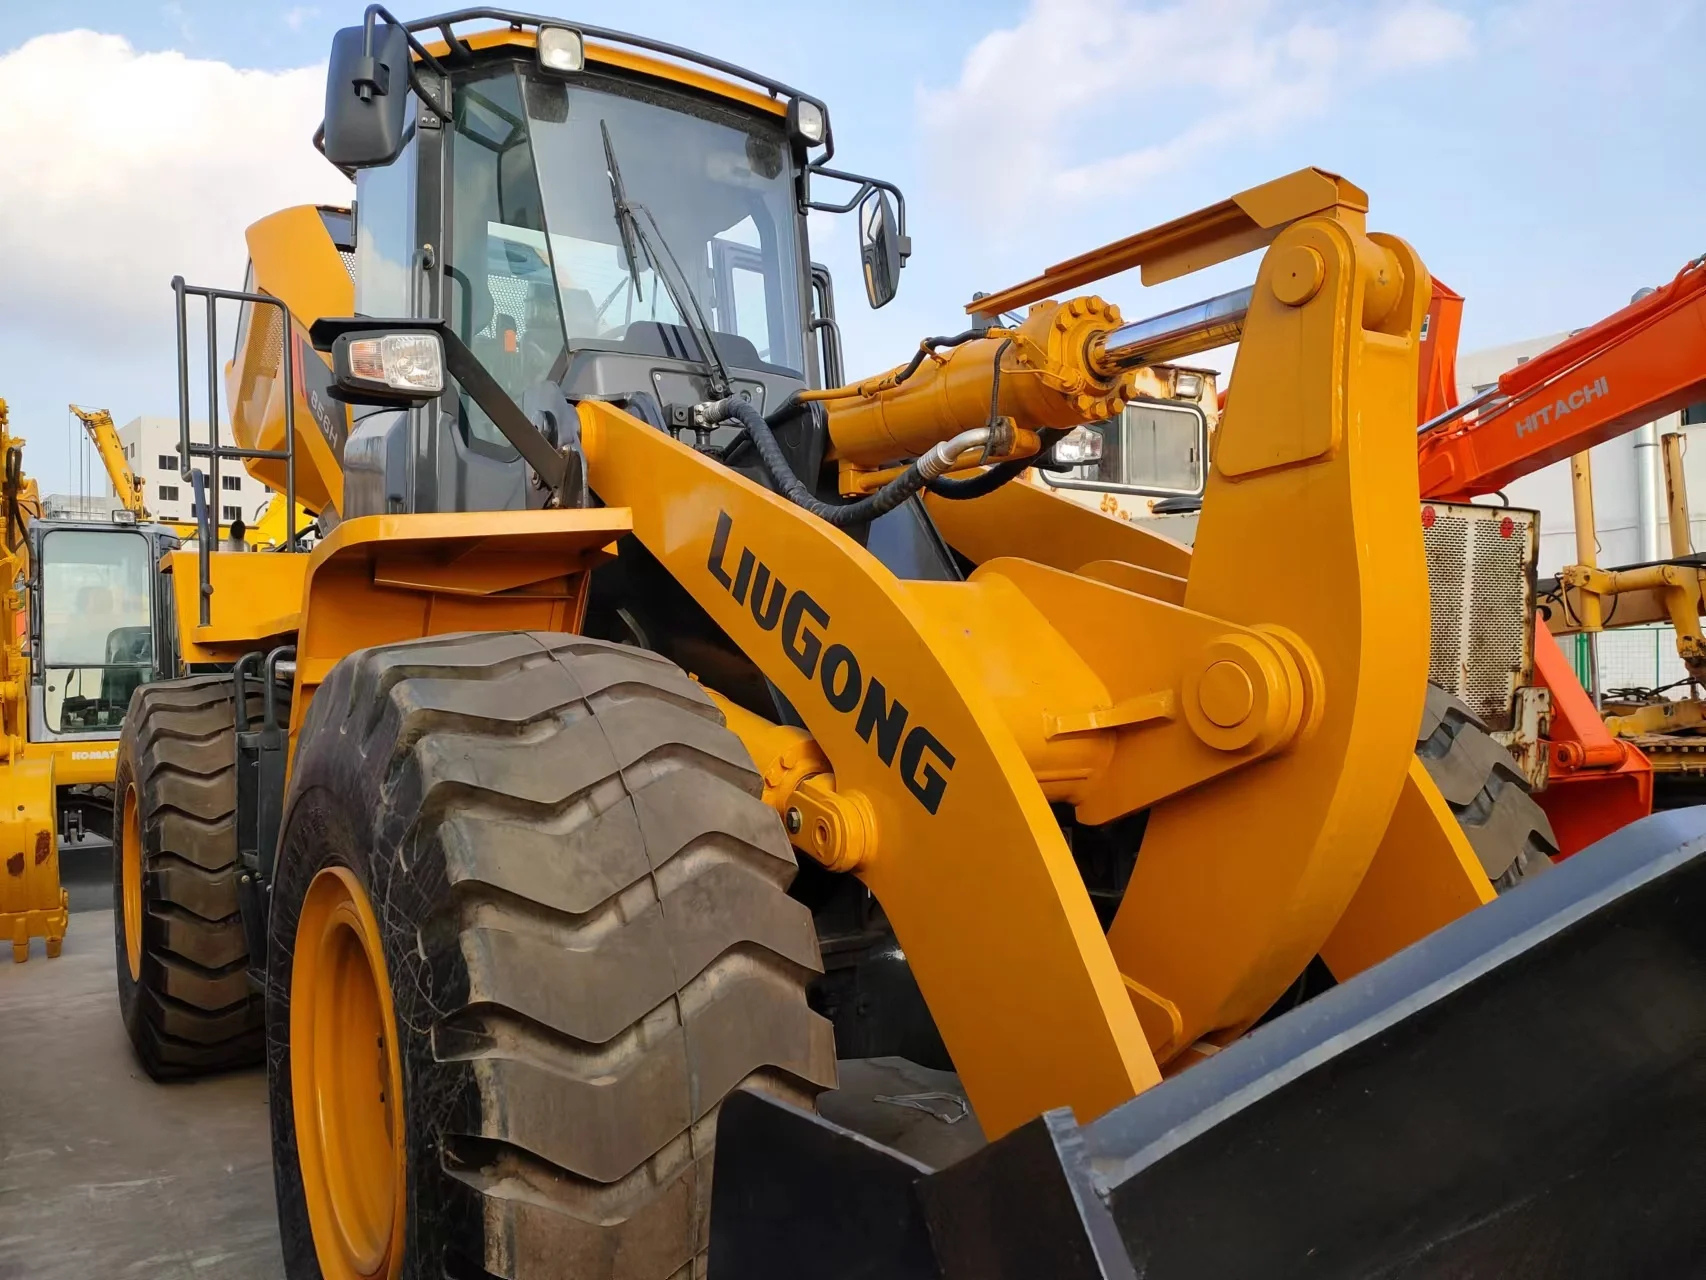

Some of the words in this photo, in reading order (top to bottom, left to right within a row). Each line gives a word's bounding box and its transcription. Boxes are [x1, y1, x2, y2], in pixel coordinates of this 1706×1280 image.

[311, 390, 338, 449] 856H
[1515, 376, 1609, 438] HITACHI
[707, 510, 956, 815] LIUGONG
